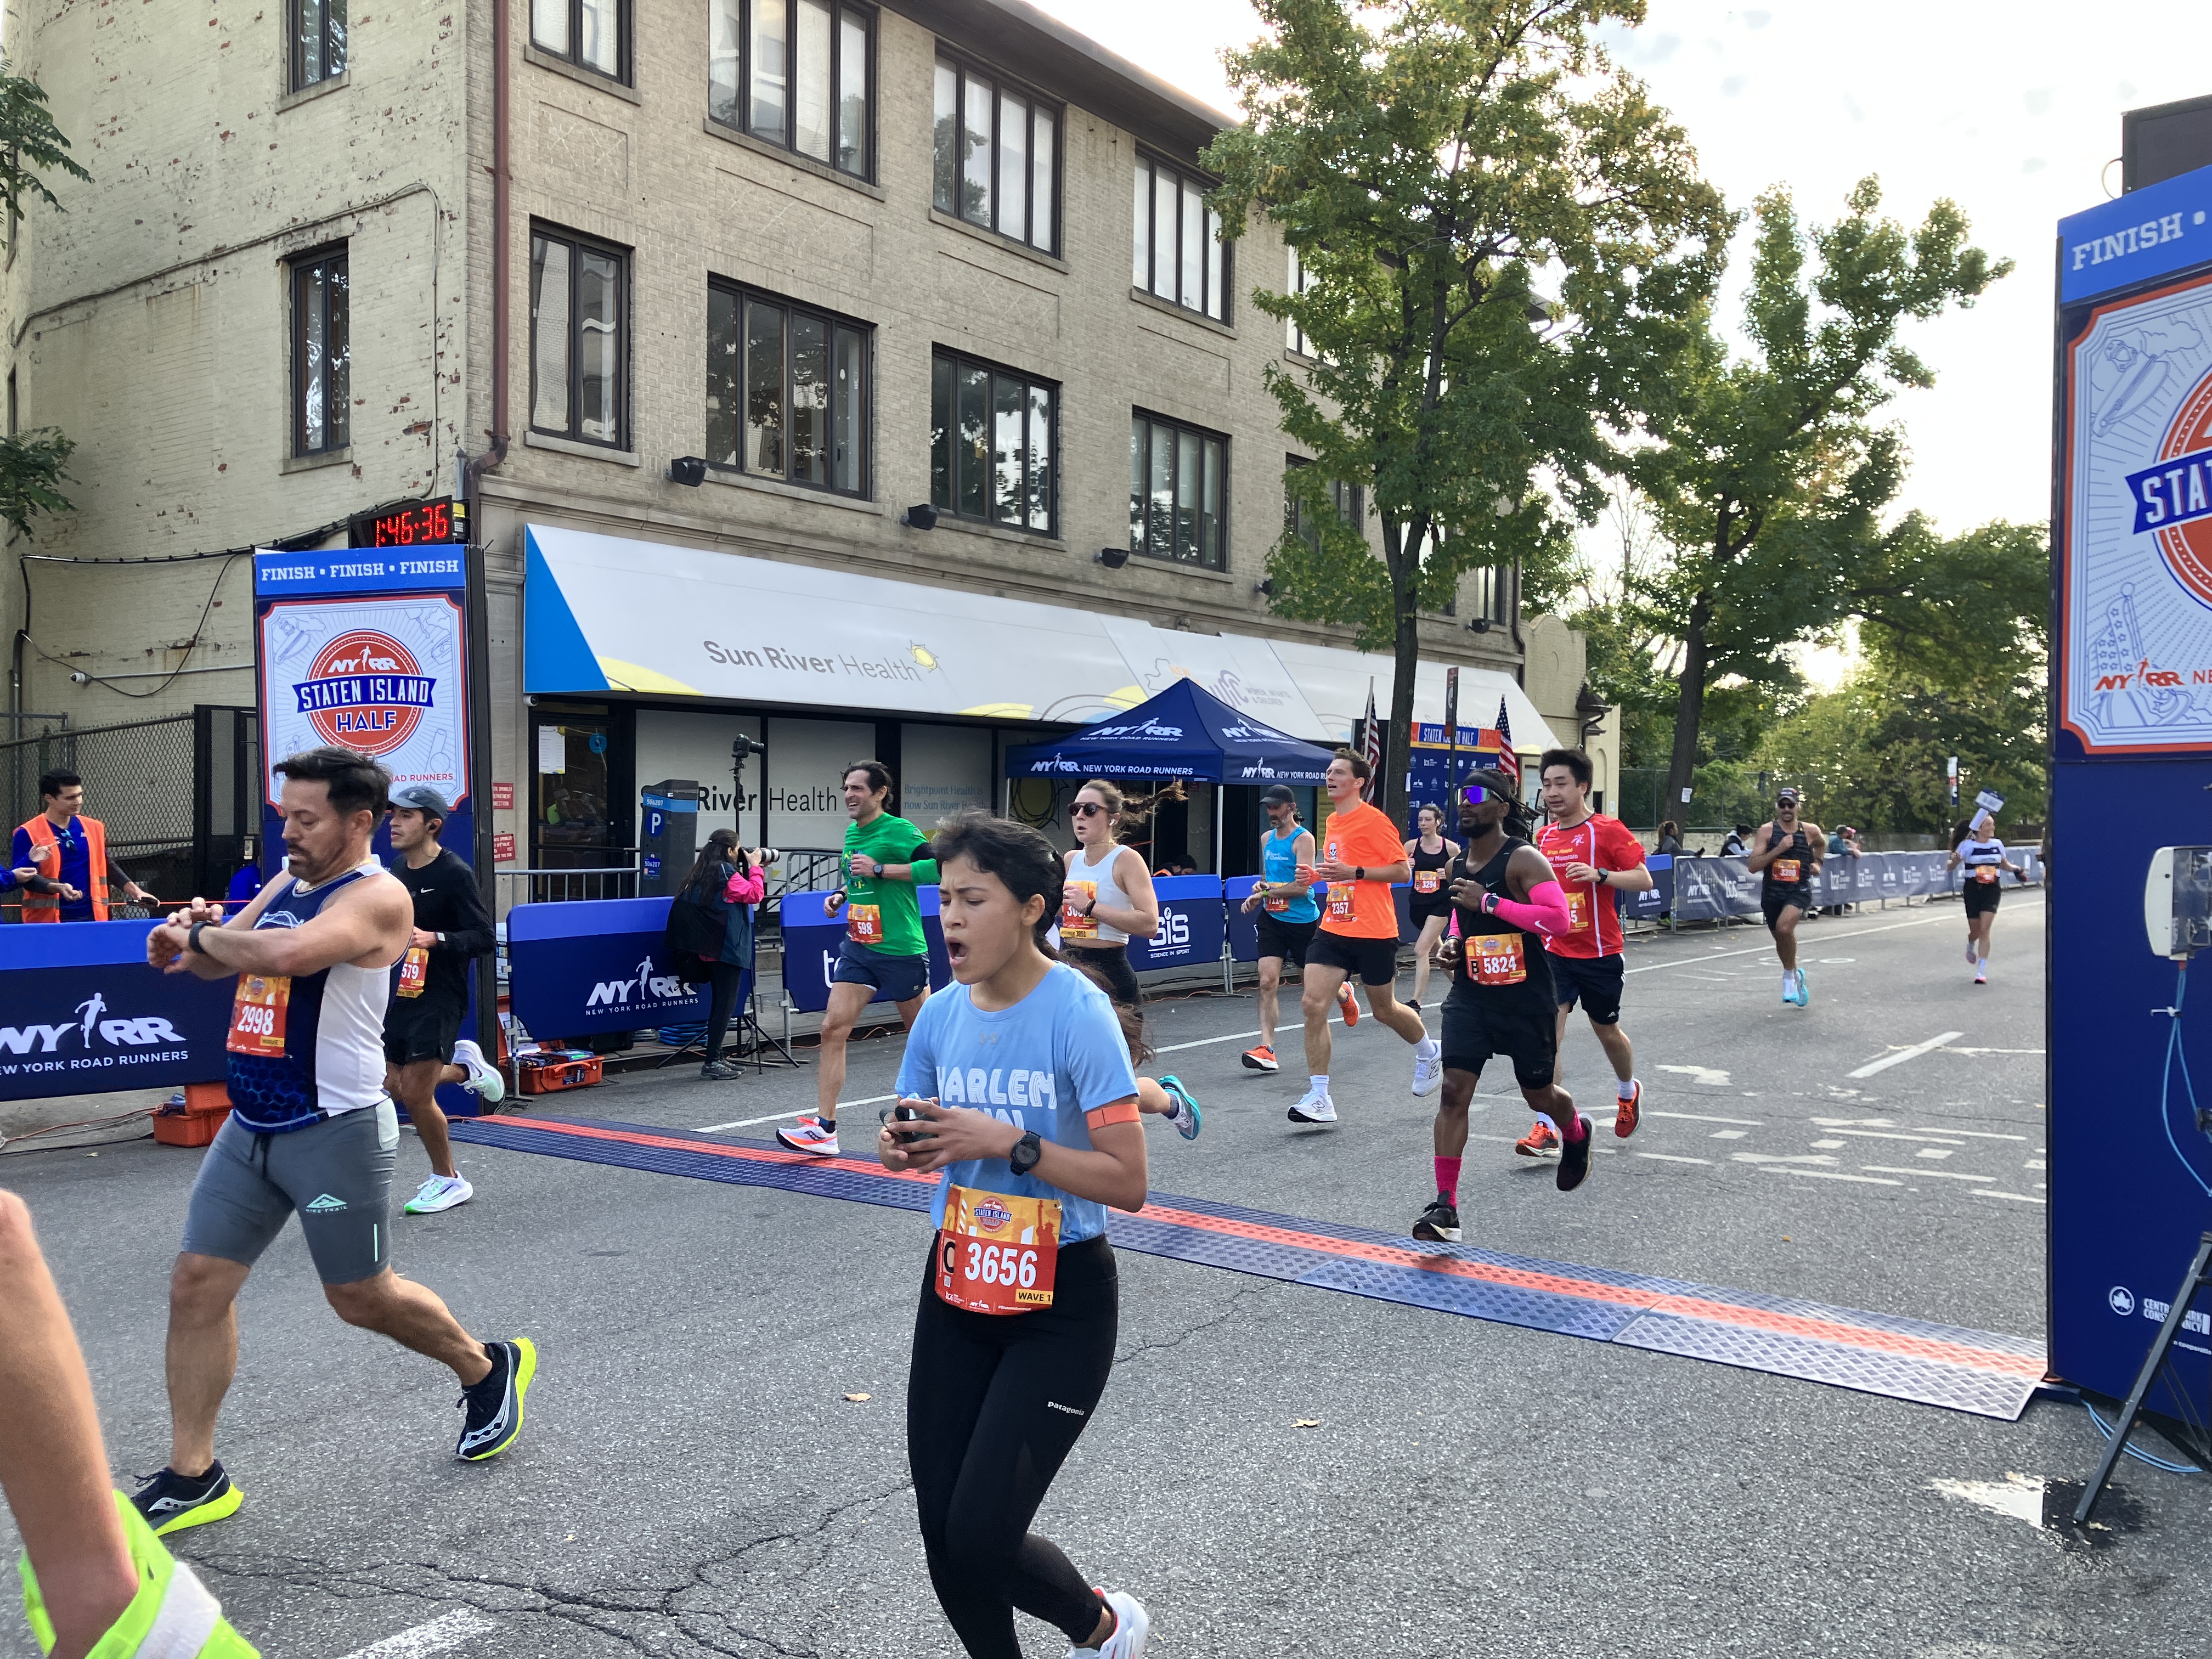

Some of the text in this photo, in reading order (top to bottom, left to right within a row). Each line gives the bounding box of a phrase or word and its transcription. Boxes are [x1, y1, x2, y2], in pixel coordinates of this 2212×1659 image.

[2072, 212, 2183, 272] FINISH
[261, 560, 459, 581] FINISH FINISH FINISH
[704, 641, 922, 681] Sun River Health
[300, 679, 429, 709] STATEN ISLAND
[336, 710, 397, 733] HALF
[1424, 728, 1442, 743] STATEN
[1462, 731, 1474, 745] HALF
[410, 773, 454, 782] RUNNERS
[1030, 761, 1081, 772] NYRR
[1104, 765, 1126, 773] YORK
[1153, 766, 1193, 775] RUNNERS
[769, 786, 837, 811] Health
[905, 784, 949, 797] Brightpoint
[951, 785, 975, 795] Health
[905, 802, 922, 810] now
[923, 800, 938, 810] Sun
[940, 800, 960, 810] River
[651, 813, 661, 834] P
[1332, 902, 1348, 915] 2357
[857, 922, 873, 935] 598
[1471, 955, 1517, 974] B 5824
[662, 998, 698, 1007] RUNNERS
[237, 1005, 274, 1035] 2998
[22, 1061, 65, 1073] YORK
[71, 1057, 114, 1069] ROAD
[119, 1051, 189, 1065] RUNNERS
[975, 1209, 1011, 1221] STATEN ISLAND
[964, 1242, 1038, 1288] 3656
[1018, 1292, 1045, 1301] WAVE
[2144, 1298, 2203, 1323] CENTR ARK
[1047, 1401, 1085, 1415] patagonia
